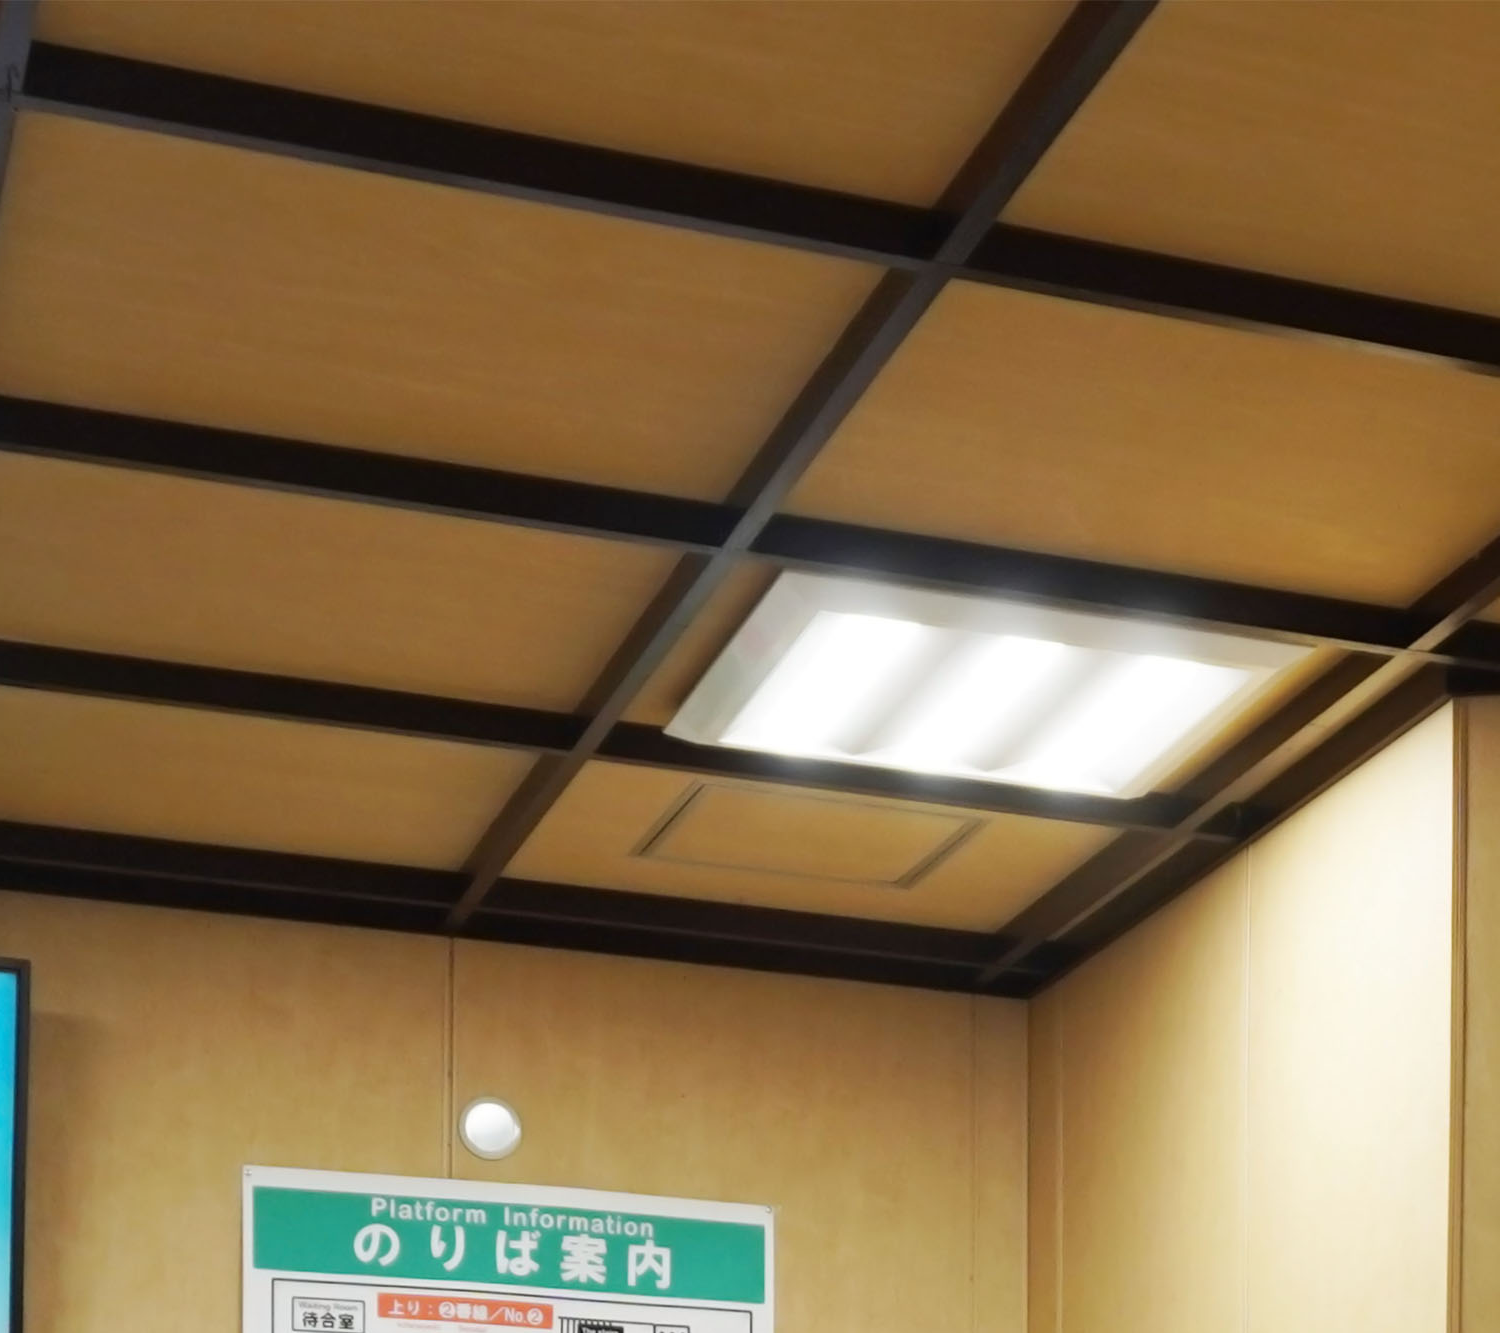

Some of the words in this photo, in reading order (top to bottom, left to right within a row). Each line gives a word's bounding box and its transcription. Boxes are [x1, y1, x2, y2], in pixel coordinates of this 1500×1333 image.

[370, 1197, 487, 1225] Platform
[503, 1205, 655, 1238] Information
[353, 1223, 673, 1290] のりば案内
[302, 1311, 355, 1330] 待合室
